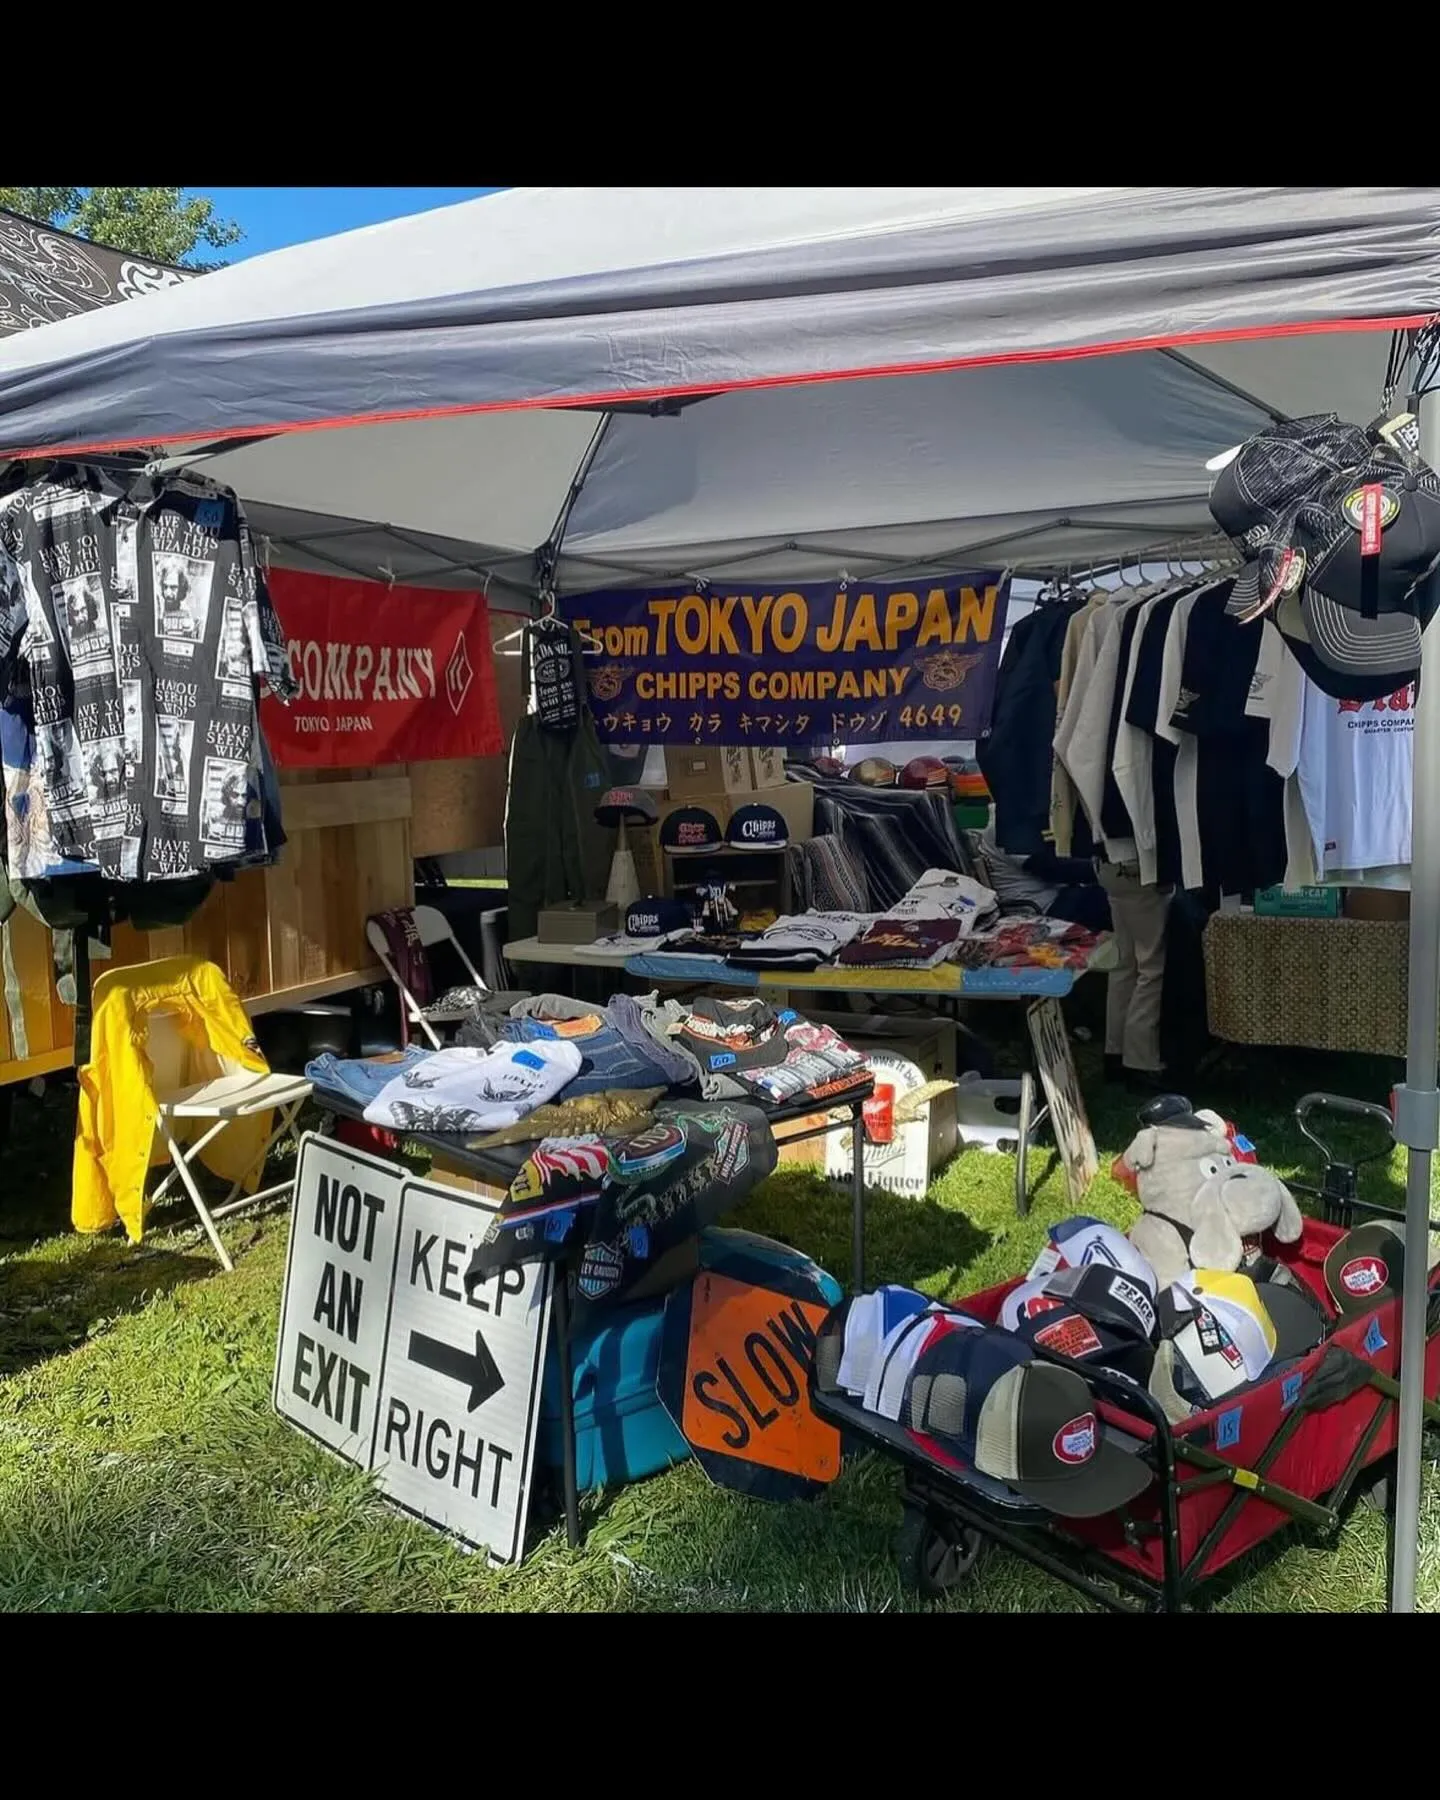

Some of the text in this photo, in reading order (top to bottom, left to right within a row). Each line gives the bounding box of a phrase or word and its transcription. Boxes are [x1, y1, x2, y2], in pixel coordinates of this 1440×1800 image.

[184, 531, 218, 549] THIS
[648, 592, 808, 656] TOKYO
[816, 586, 1000, 652] JAPAN
[286, 639, 437, 701] COMPANY
[636, 666, 910, 700] CHIPPS COMPANY
[209, 720, 251, 738] HAVE
[294, 716, 373, 733] TOKYO JAPAN
[595, 703, 962, 735] ウキョウ カラ キマシタ ドウゾ 4649
[206, 731, 246, 748] SEEN
[215, 744, 251, 761] WIZA
[151, 850, 188, 864] SEEN
[152, 837, 191, 853] HAVE
[867, 1170, 924, 1190] Liquor
[314, 1174, 385, 1264] NOT
[581, 1261, 599, 1277] LEY
[313, 1261, 364, 1345] AN
[1115, 1280, 1154, 1326] PEACE
[292, 1331, 370, 1436] EXIT
[692, 1301, 817, 1450] SLOW
[384, 1396, 513, 1509] RIGHT
